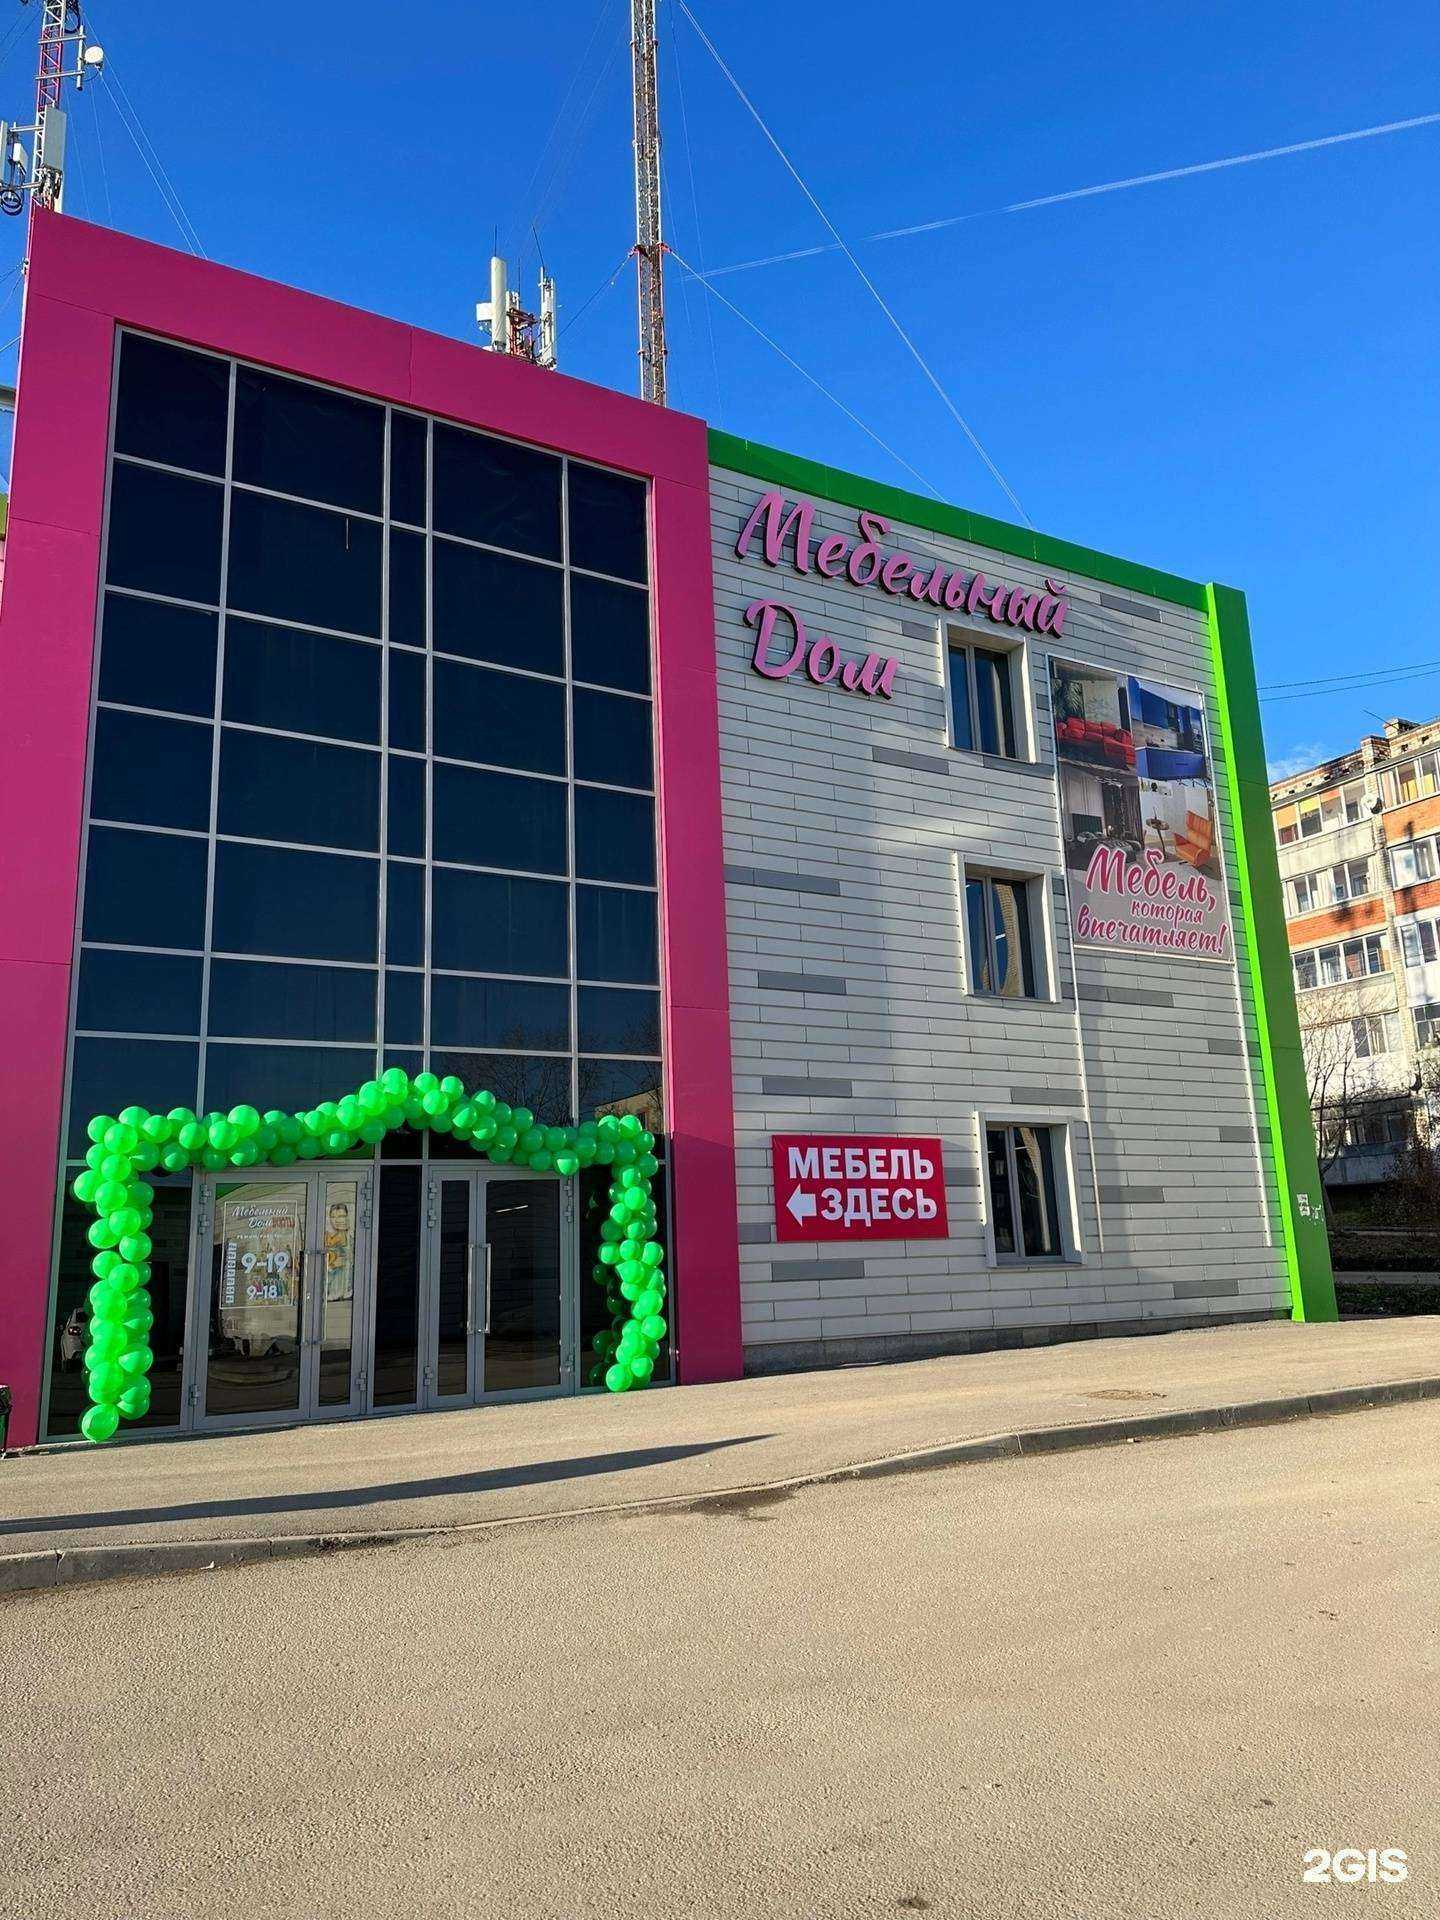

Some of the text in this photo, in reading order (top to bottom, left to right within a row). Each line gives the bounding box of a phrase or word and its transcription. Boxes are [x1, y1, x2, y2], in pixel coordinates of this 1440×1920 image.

[734, 491, 1071, 639] Мебельный
[743, 599, 900, 699] Дом
[1086, 844, 1216, 912] Мебель,
[1077, 903, 1229, 954] впечатляет!
[1130, 900, 1204, 928] которая
[788, 1147, 934, 1180] МЕБЕЛЬ
[821, 1187, 938, 1227] ЗДЕСЬ
[241, 1251, 290, 1274] 9-19
[246, 1285, 278, 1300] 9-18
